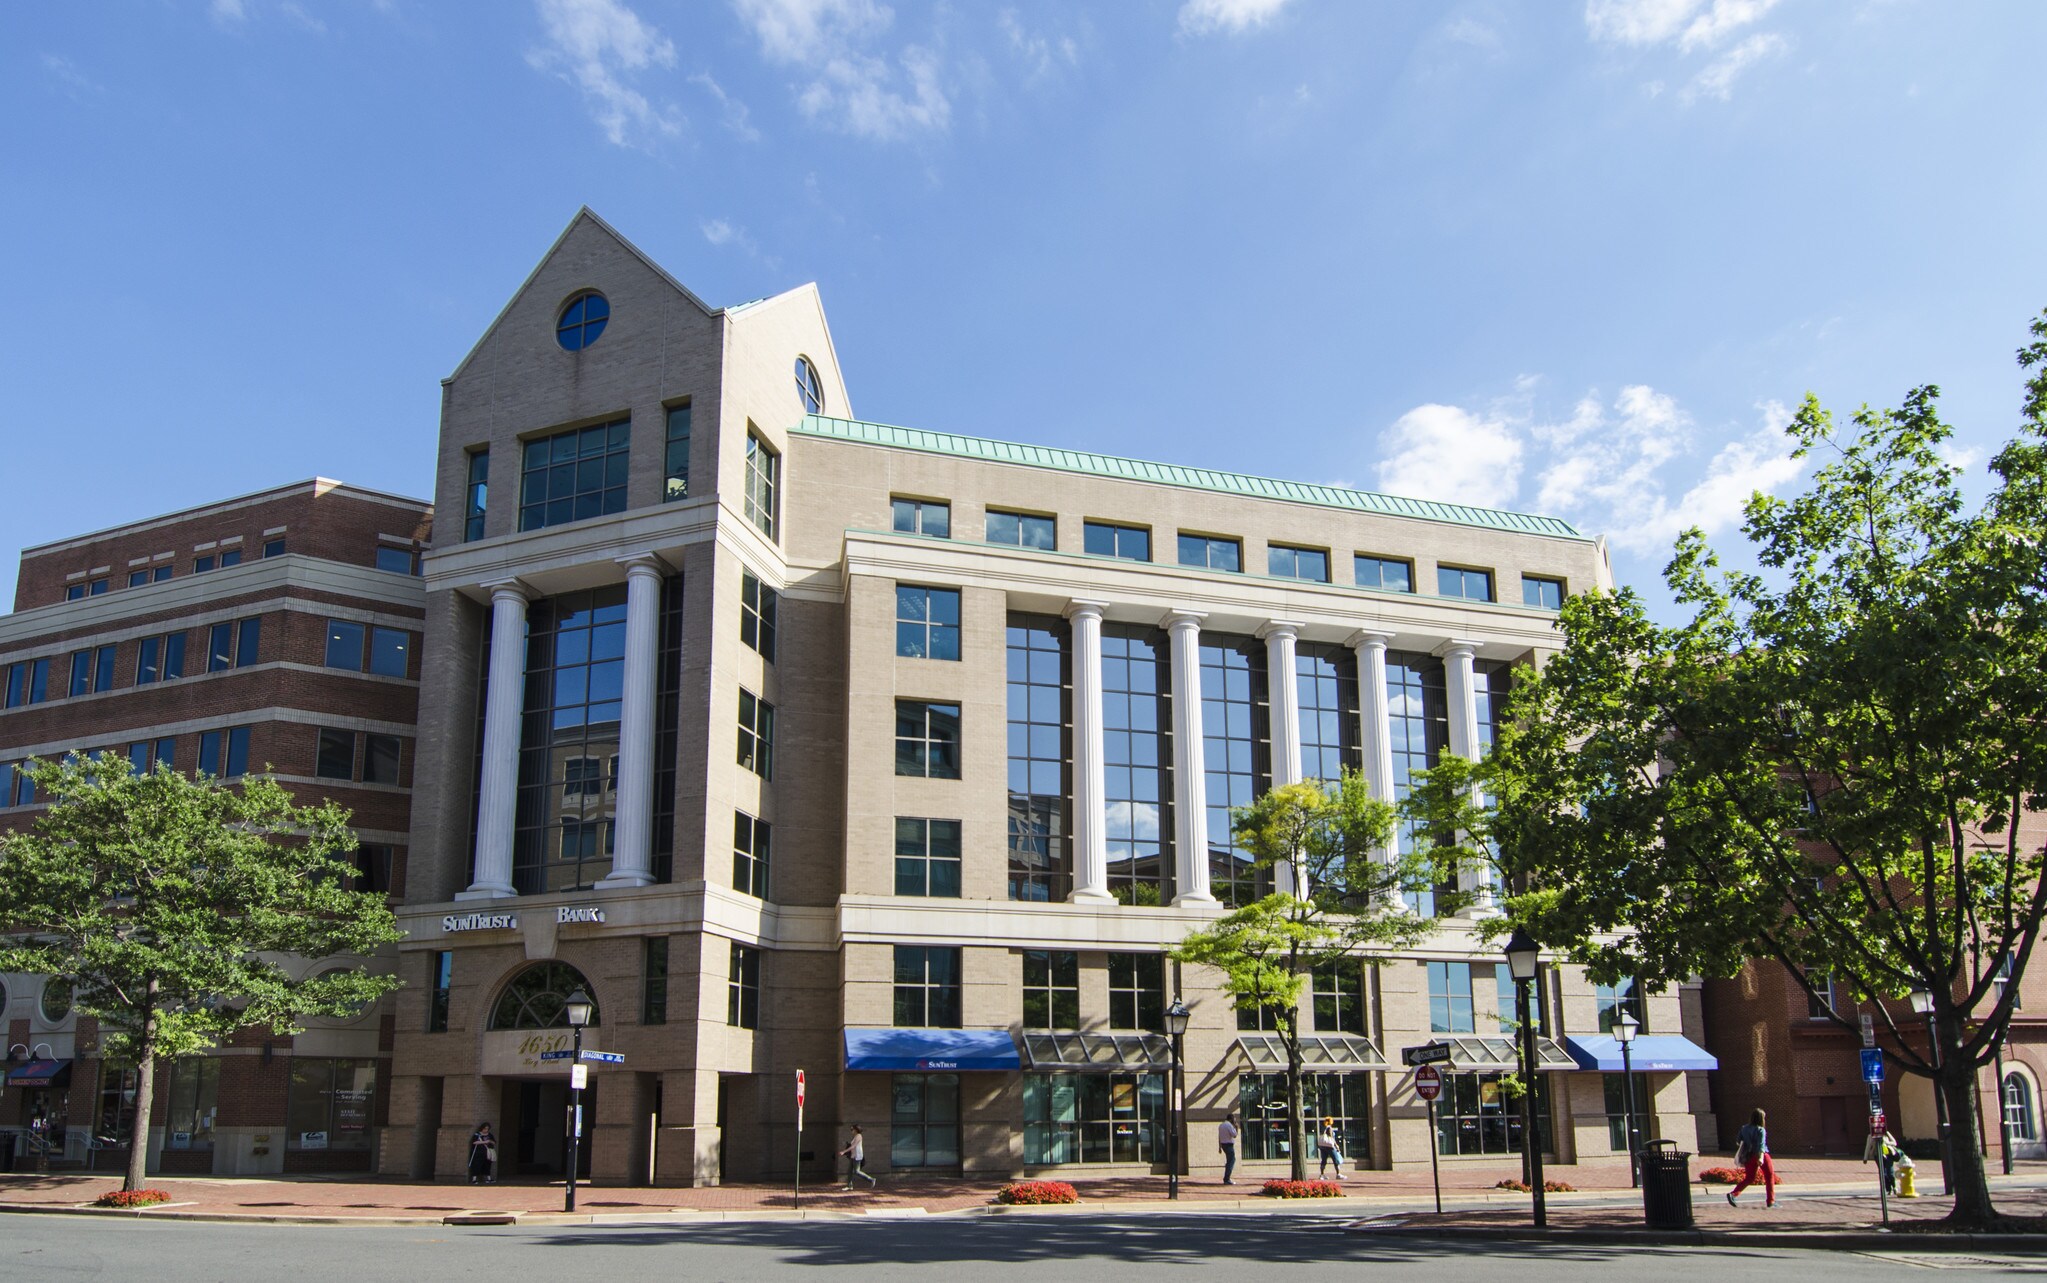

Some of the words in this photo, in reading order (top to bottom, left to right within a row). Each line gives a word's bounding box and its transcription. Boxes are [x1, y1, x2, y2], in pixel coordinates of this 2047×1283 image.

[557, 907, 599, 924] BANK
[518, 1034, 568, 1055] 1650
[583, 1051, 605, 1061] DIAGONAL
[1420, 1051, 1431, 1059] ONE
[1433, 1049, 1446, 1057] WAY
